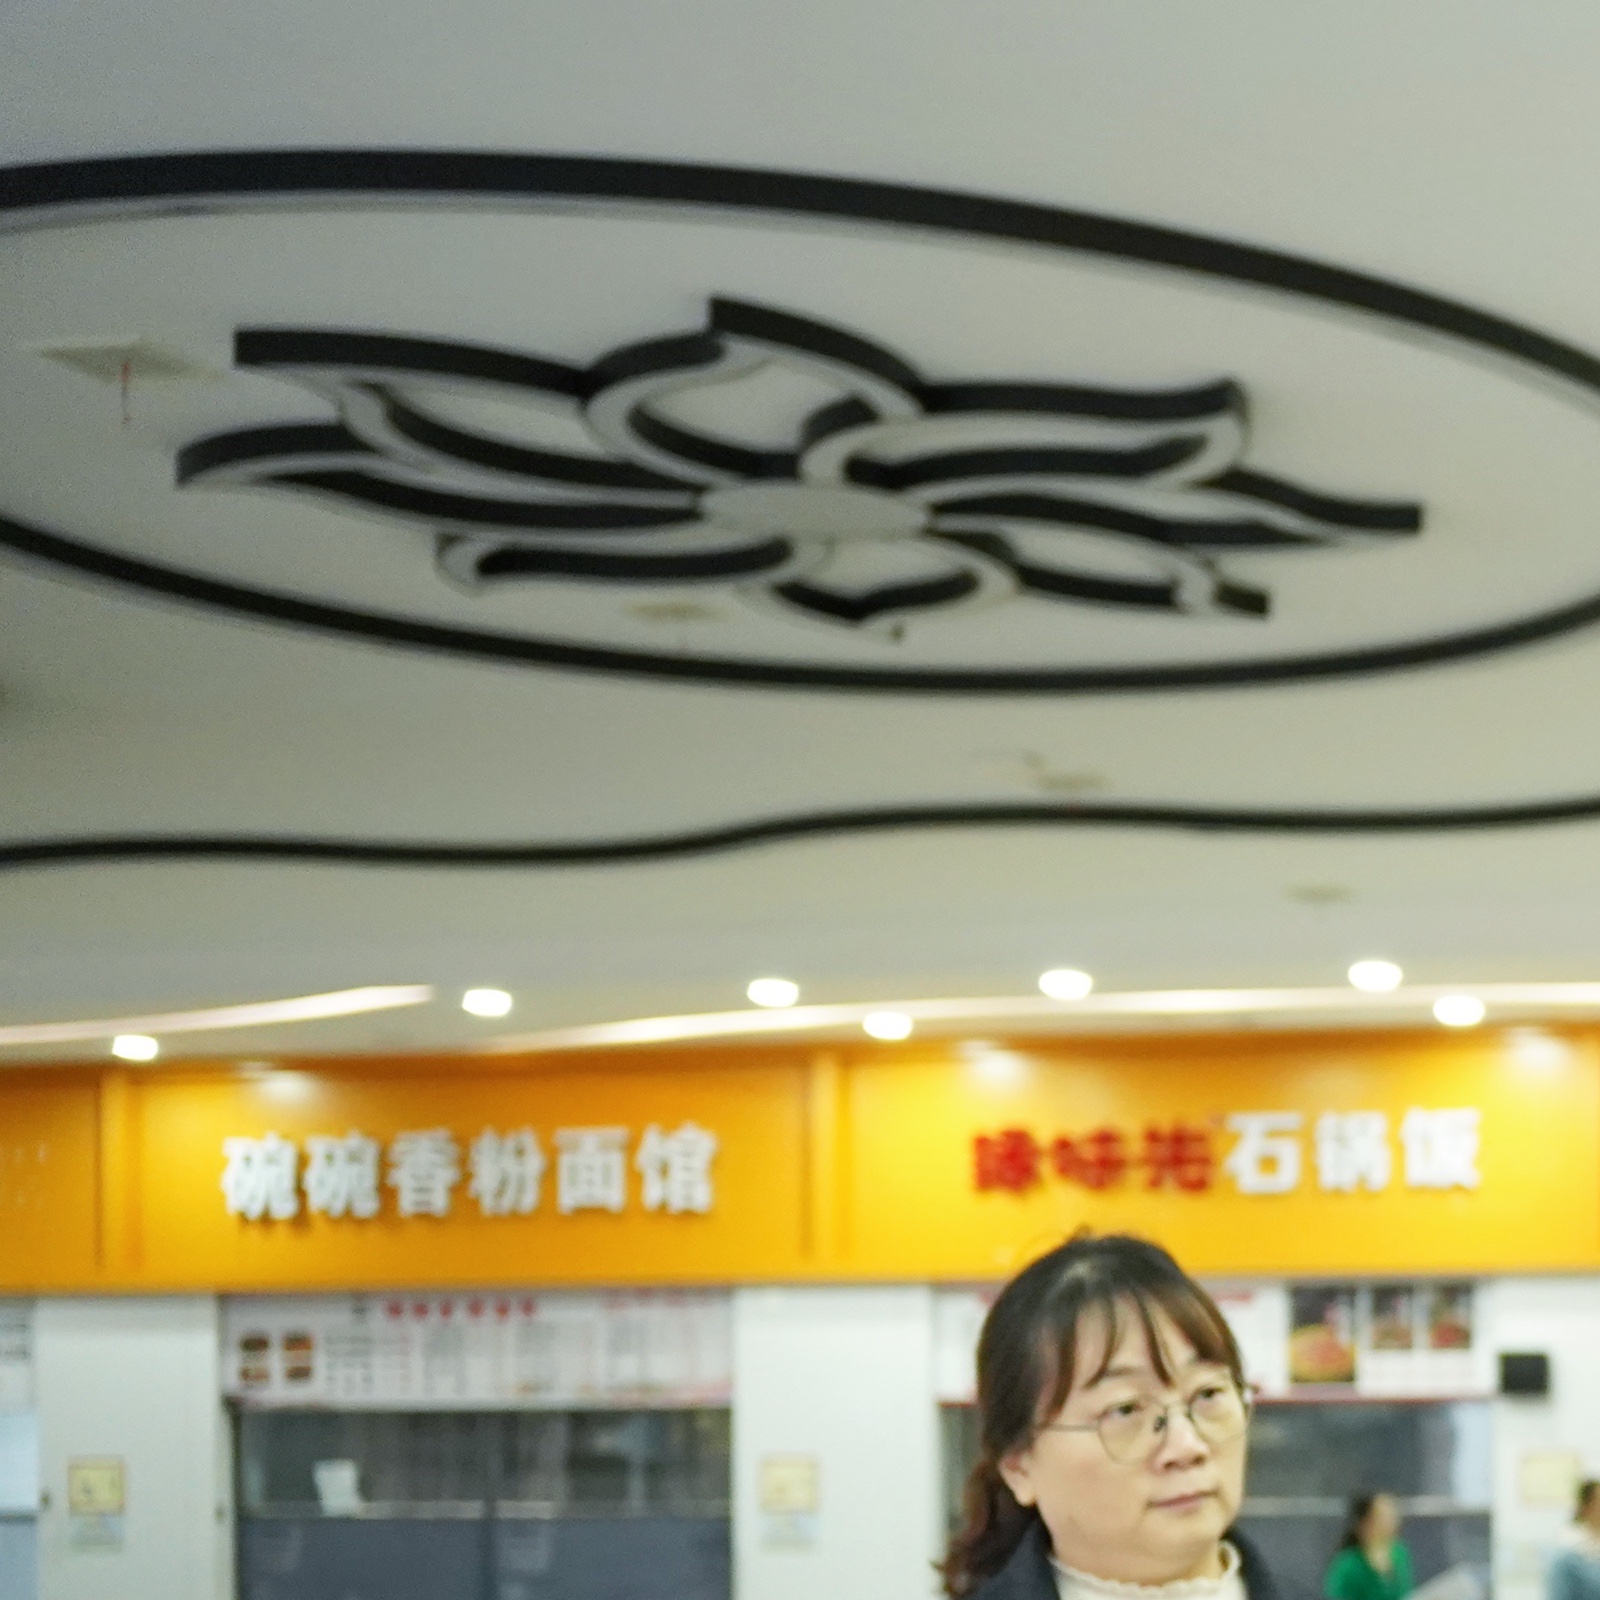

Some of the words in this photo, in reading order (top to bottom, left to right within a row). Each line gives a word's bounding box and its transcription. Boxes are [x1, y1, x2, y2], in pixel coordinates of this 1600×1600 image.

[221, 1121, 718, 1221] 碗碗香粉面馆
